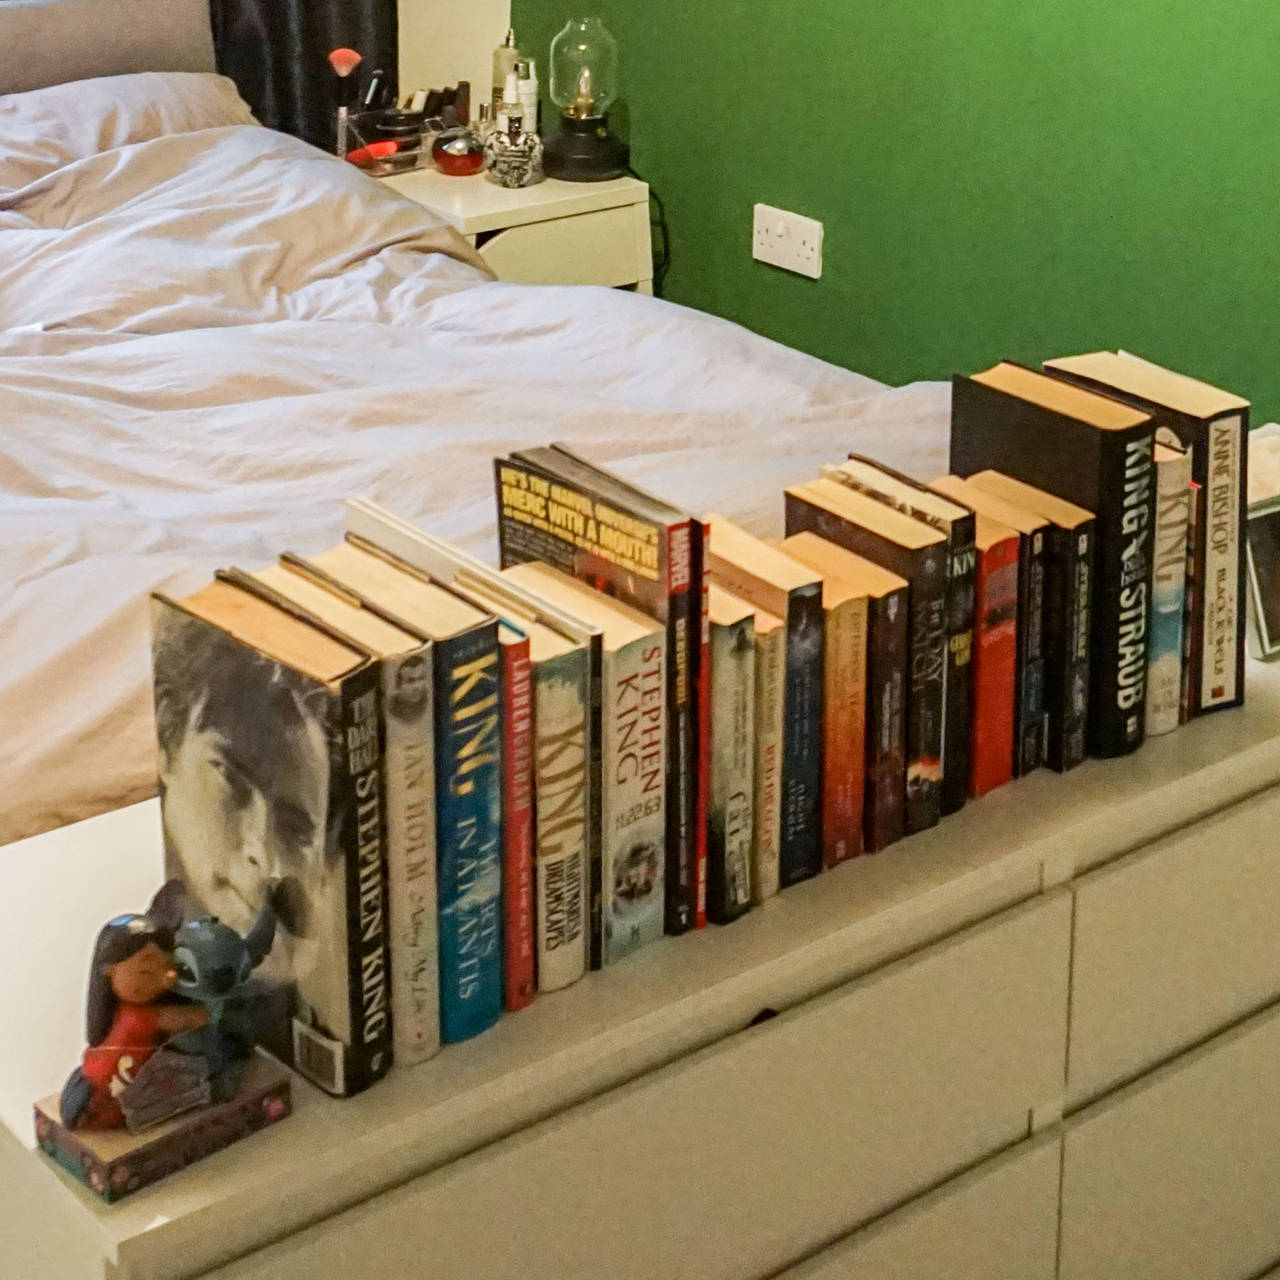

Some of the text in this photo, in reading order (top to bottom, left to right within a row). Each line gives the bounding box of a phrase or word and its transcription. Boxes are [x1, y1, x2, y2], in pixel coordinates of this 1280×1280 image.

[502, 484, 546, 518] MERC
[548, 501, 585, 541] WITH
[586, 517, 597, 545] A
[1122, 436, 1152, 535] KING
[1155, 488, 1194, 583] KING
[1211, 427, 1231, 555] ANNE BISHOP
[669, 526, 690, 588] MARVEL
[512, 657, 531, 733] LAUREN
[1117, 582, 1146, 710] STRAUB
[404, 742, 424, 789] IAN
[450, 651, 498, 797] KING
[616, 673, 639, 785] KING
[640, 645, 662, 794] STEPHEN
[405, 799, 426, 882] HOLM
[537, 721, 585, 857] KING
[356, 770, 387, 1043] STEPHEN KING
[456, 817, 482, 999] IN ATANTIS
[545, 859, 566, 951] DREAMSCAPES
